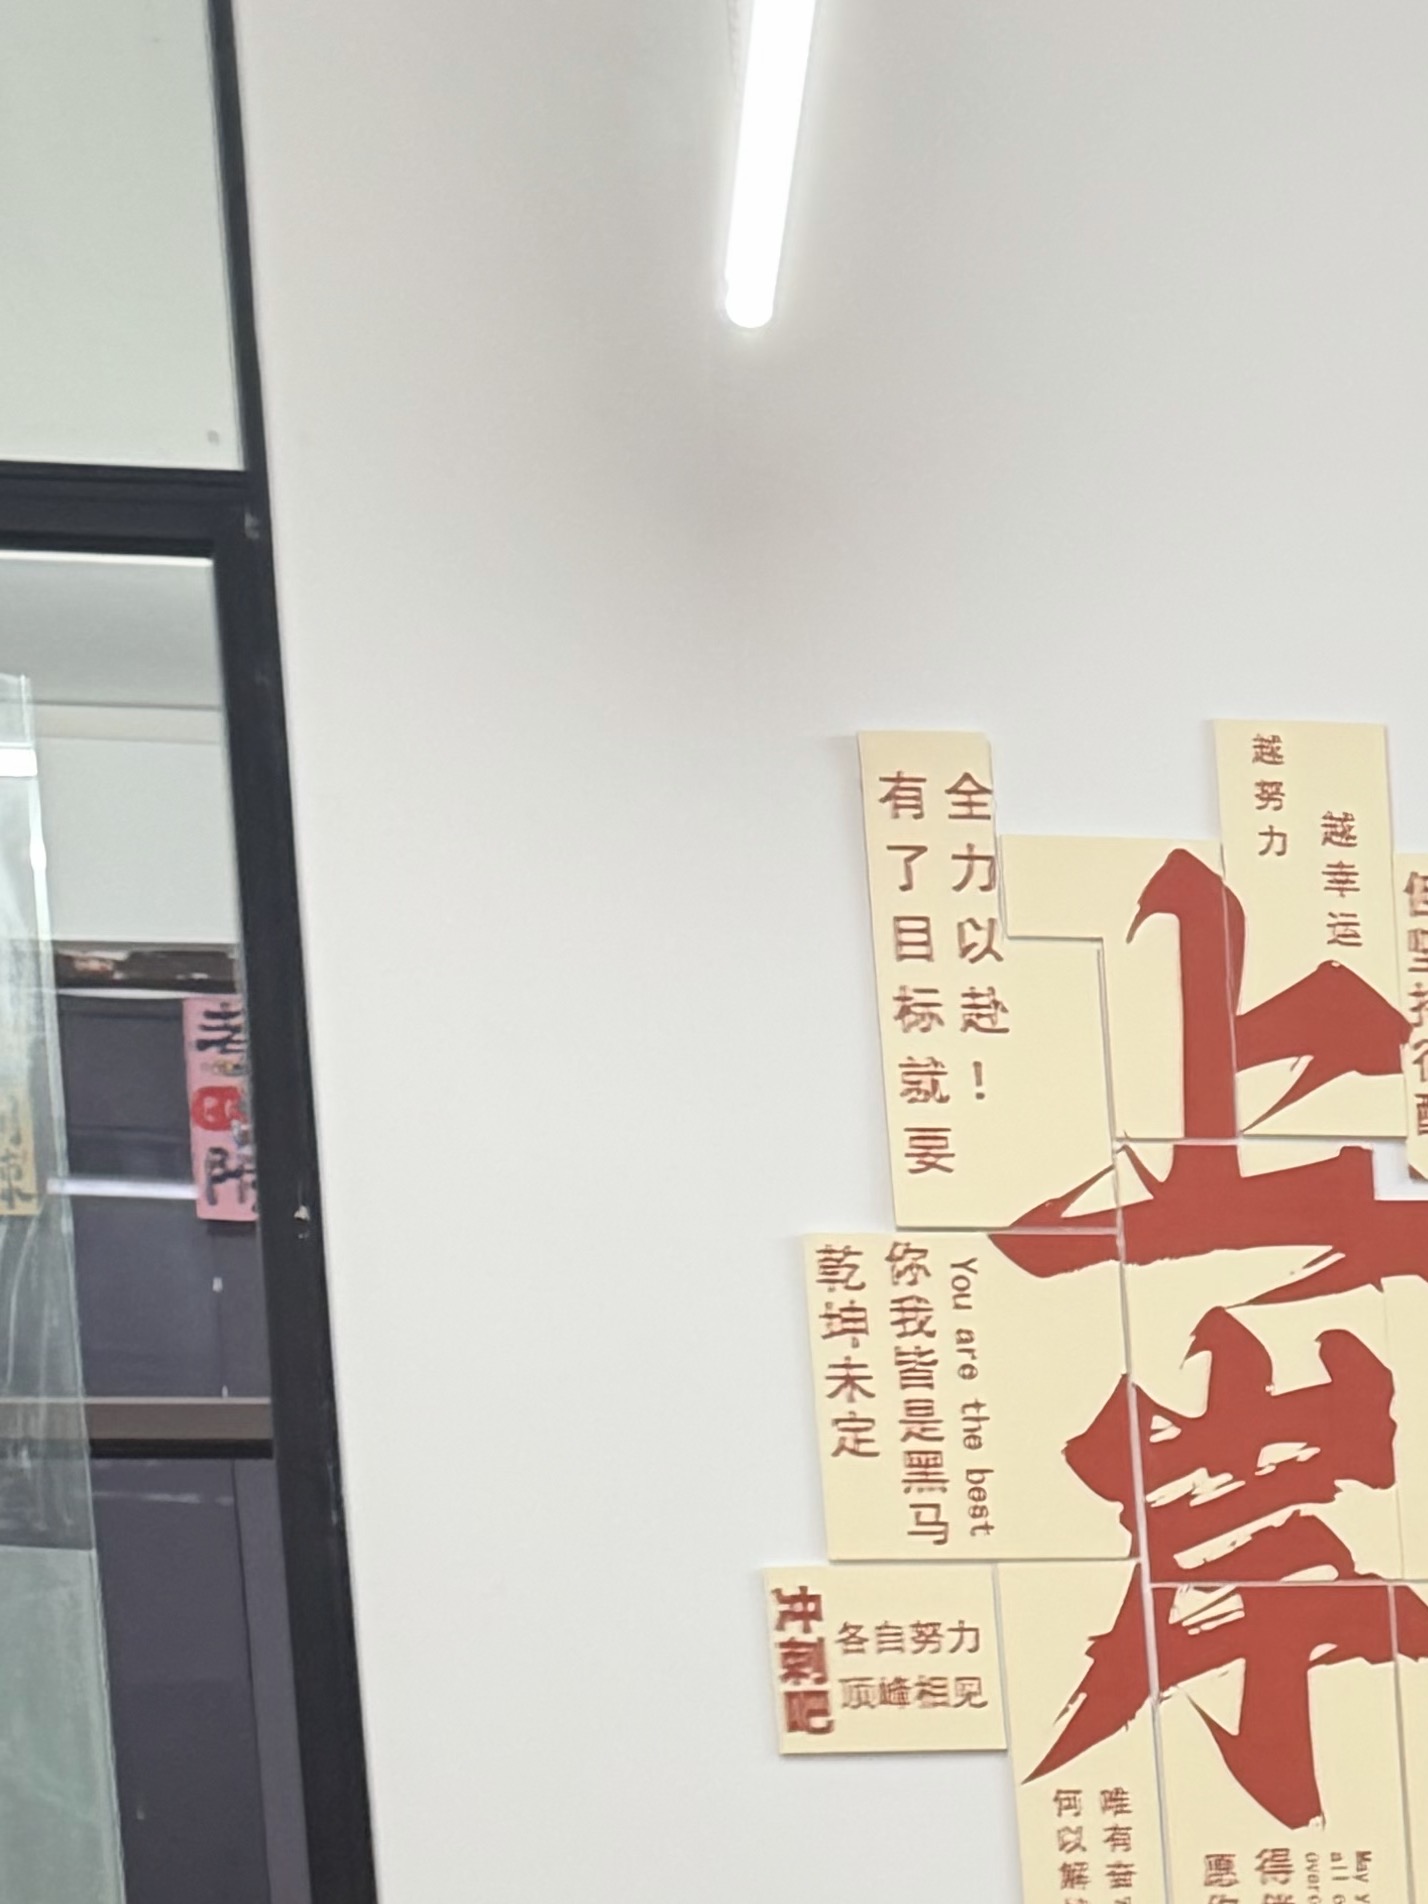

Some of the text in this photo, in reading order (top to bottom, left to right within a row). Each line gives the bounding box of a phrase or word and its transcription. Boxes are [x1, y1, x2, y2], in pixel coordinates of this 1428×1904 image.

[1252, 732, 1287, 857] 越努力
[1320, 810, 1363, 948] 越幸运
[878, 770, 956, 1175] 有了目标就要
[815, 1243, 881, 1458] 乾坤未定
[884, 1241, 951, 1546] 你我皆是黑马
[949, 1257, 996, 1538] You are the best
[771, 1585, 836, 1735] 冲刺吧
[835, 1620, 981, 1655] 各自努力
[838, 1675, 989, 1709] 顶峰相见
